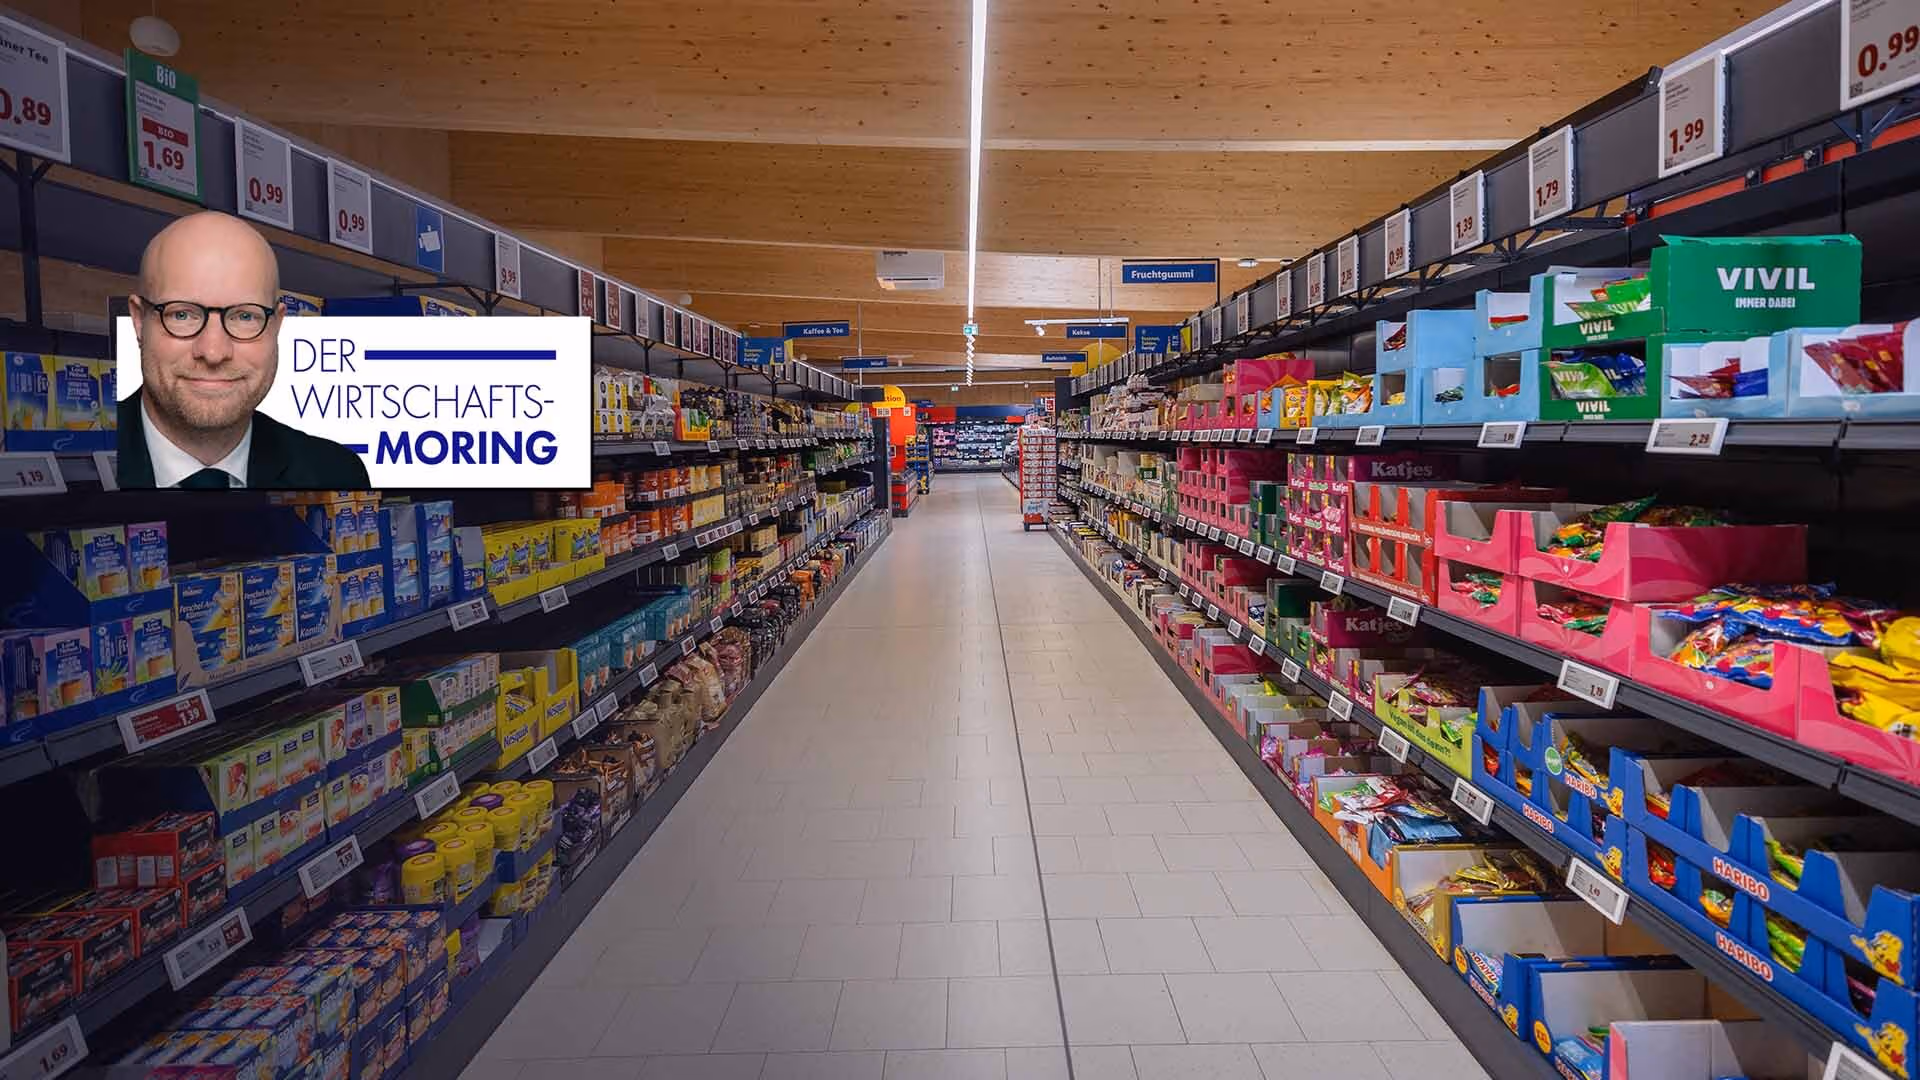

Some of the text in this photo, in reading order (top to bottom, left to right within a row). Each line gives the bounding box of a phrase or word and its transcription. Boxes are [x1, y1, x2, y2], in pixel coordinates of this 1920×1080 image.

[1857, 25, 1920, 78] 0.99
[1669, 119, 1704, 154] 1.99
[143, 141, 185, 170] 1.69
[249, 177, 283, 205] 0.99
[1536, 180, 1558, 207] 1.79
[338, 209, 365, 232] 0.99
[1456, 216, 1473, 239] 1.39
[1131, 269, 1194, 279] Fruchtgummi
[1717, 268, 1815, 290] VIVIL
[1735, 297, 1796, 308] IMMER DABEI
[1371, 461, 1433, 479] Katjes
[1345, 617, 1402, 634] Katjes
[179, 707, 200, 727] 1.39
[1564, 772, 1597, 800] HARIBO
[1522, 803, 1554, 834] HARIBO
[1713, 857, 1769, 902] HARIBO
[1715, 931, 1773, 982] HARIBO
[40, 1044, 67, 1072] 1.69
